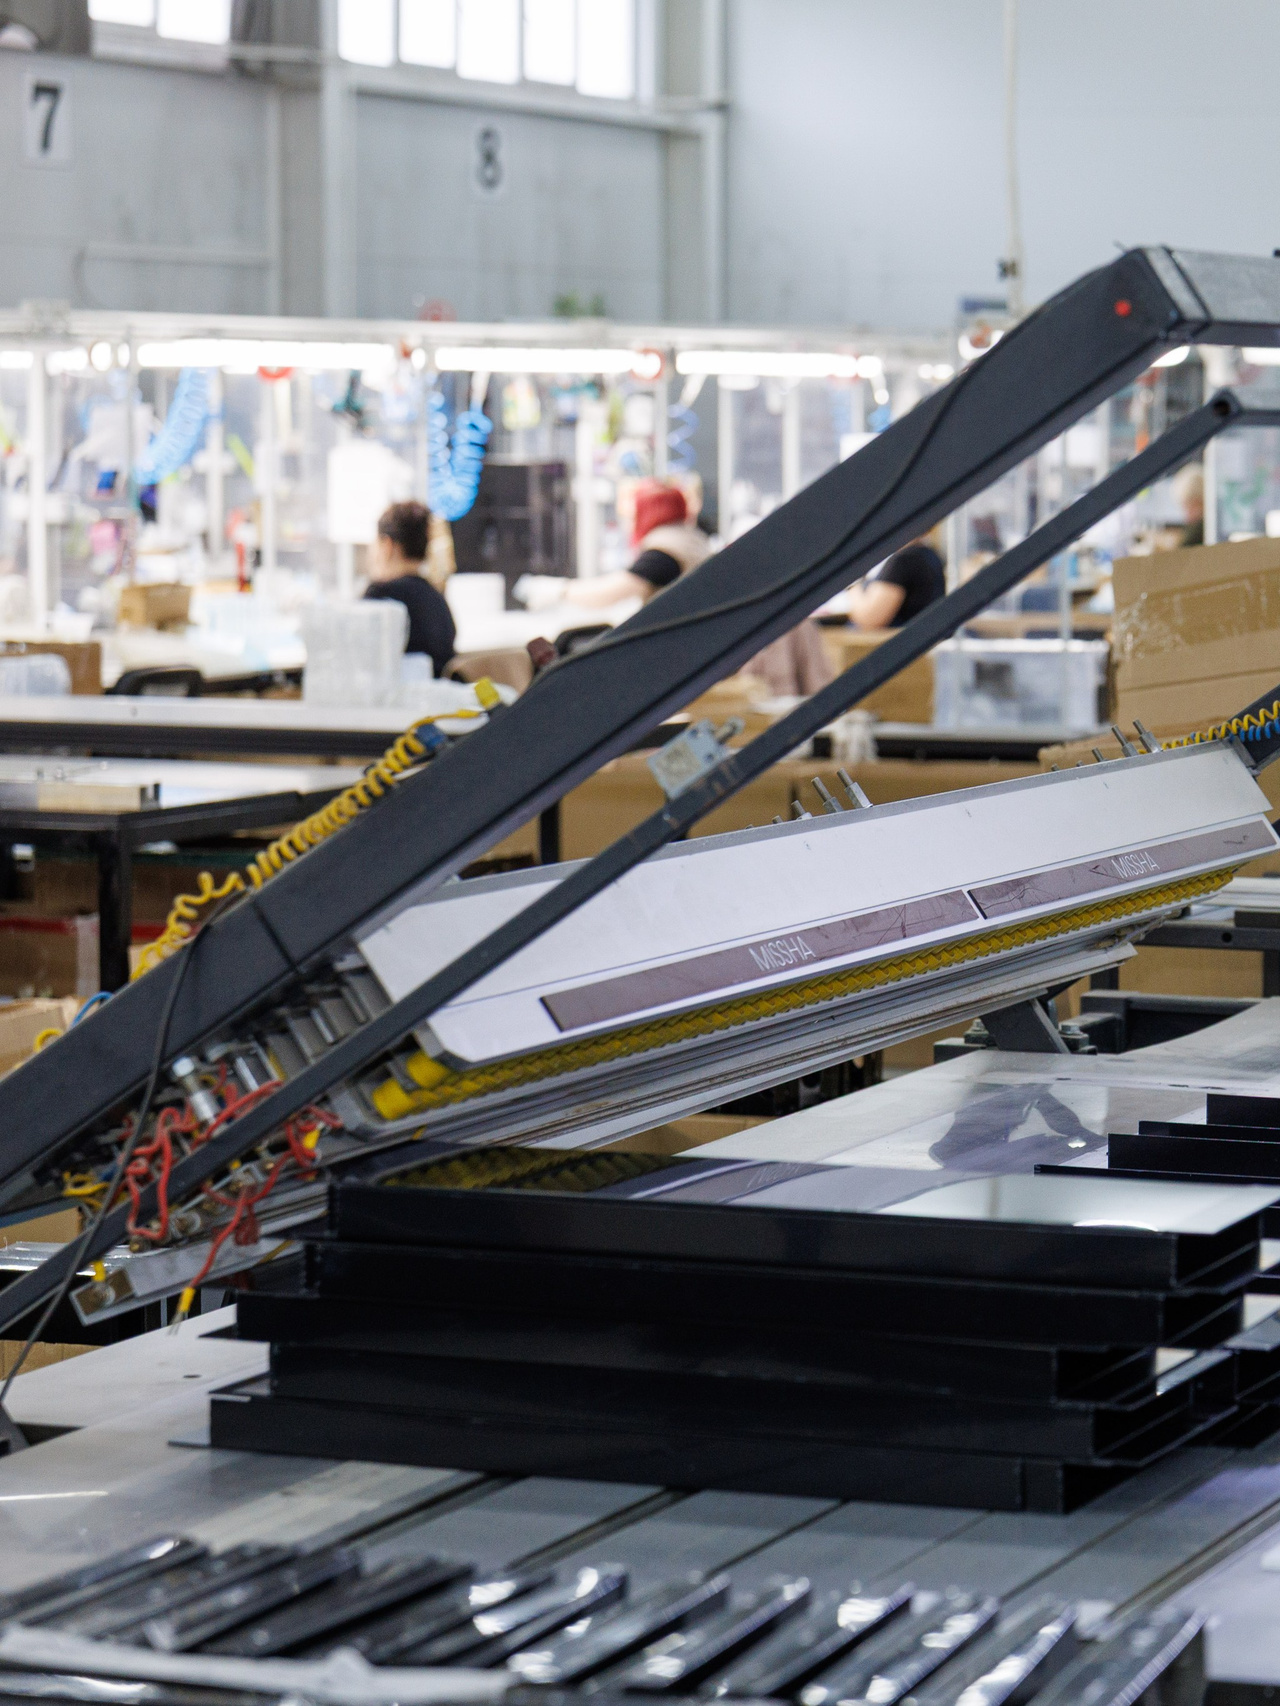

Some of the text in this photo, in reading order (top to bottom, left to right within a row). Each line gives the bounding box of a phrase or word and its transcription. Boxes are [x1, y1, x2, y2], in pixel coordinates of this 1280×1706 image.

[32, 81, 62, 154] 7
[476, 126, 502, 191] 8
[1111, 851, 1160, 879] MISSHA
[748, 935, 817, 972] MISSHA
